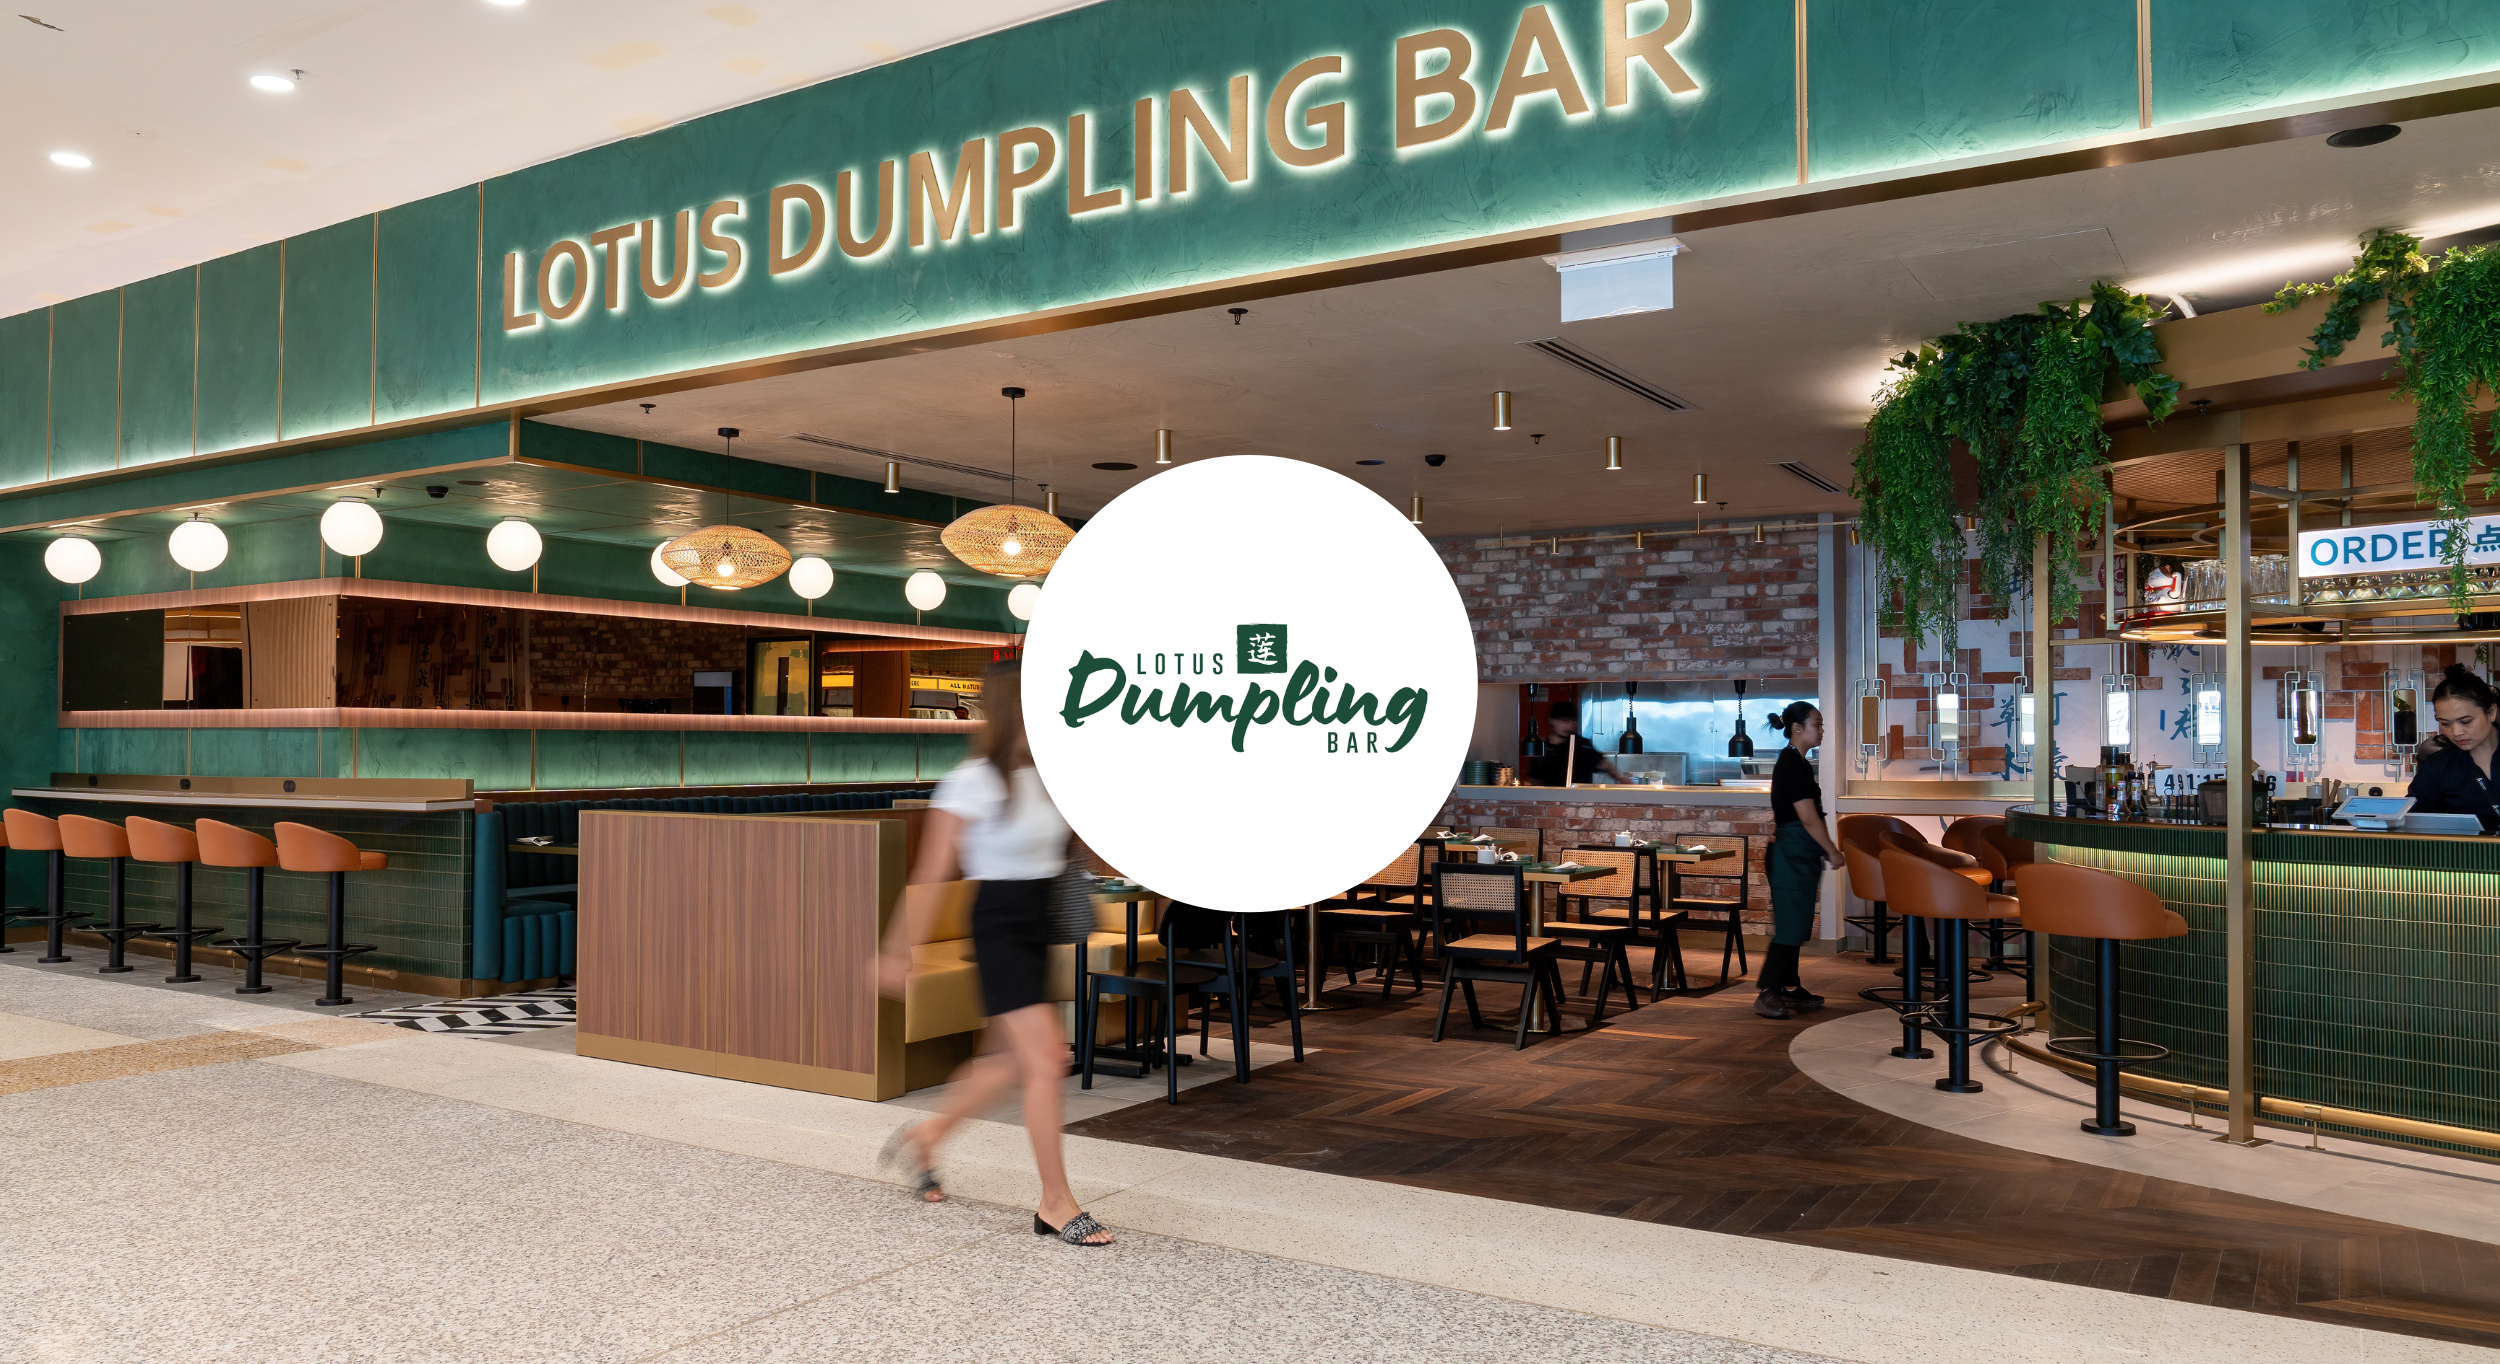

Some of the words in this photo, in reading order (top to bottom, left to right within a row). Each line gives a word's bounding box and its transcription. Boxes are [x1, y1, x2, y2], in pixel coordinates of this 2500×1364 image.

[503, 200, 742, 332] LOTUS
[769, 55, 1345, 276] DUMPLING
[1396, 0, 1700, 149] BAR
[2310, 528, 2451, 567] ORDER
